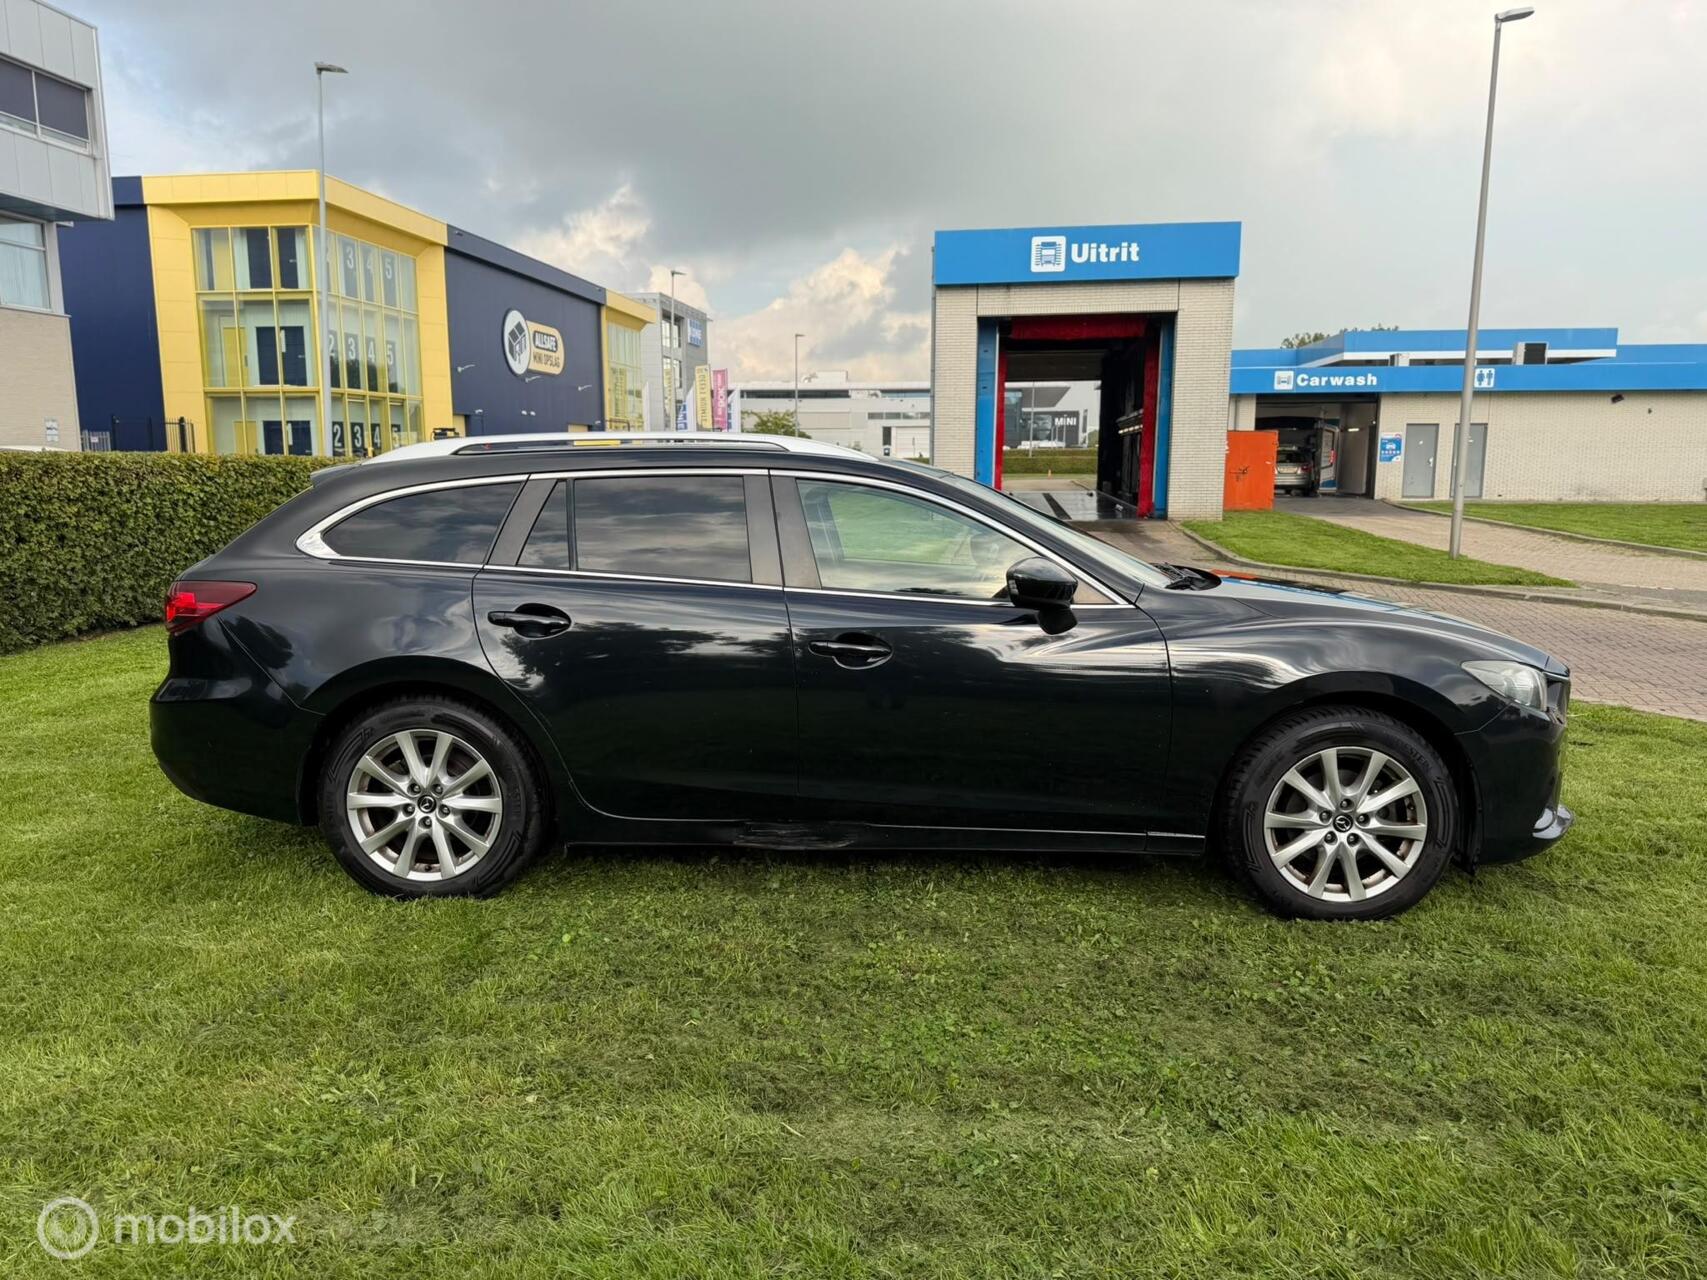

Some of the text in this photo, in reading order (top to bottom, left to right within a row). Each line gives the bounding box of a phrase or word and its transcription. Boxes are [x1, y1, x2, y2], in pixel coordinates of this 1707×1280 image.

[346, 246, 354, 269] 3
[1071, 242, 1140, 263] Uitrit
[384, 258, 393, 280] 5
[328, 334, 336, 357] 2
[347, 337, 356, 360] 3
[367, 341, 376, 363] 4
[387, 343, 394, 365] 5
[1296, 373, 1378, 387] Carwash
[1054, 417, 1077, 426] MINI
[333, 424, 342, 447] 2
[353, 425, 362, 448] 3
[373, 426, 381, 448] 4
[392, 427, 399, 448] 5
